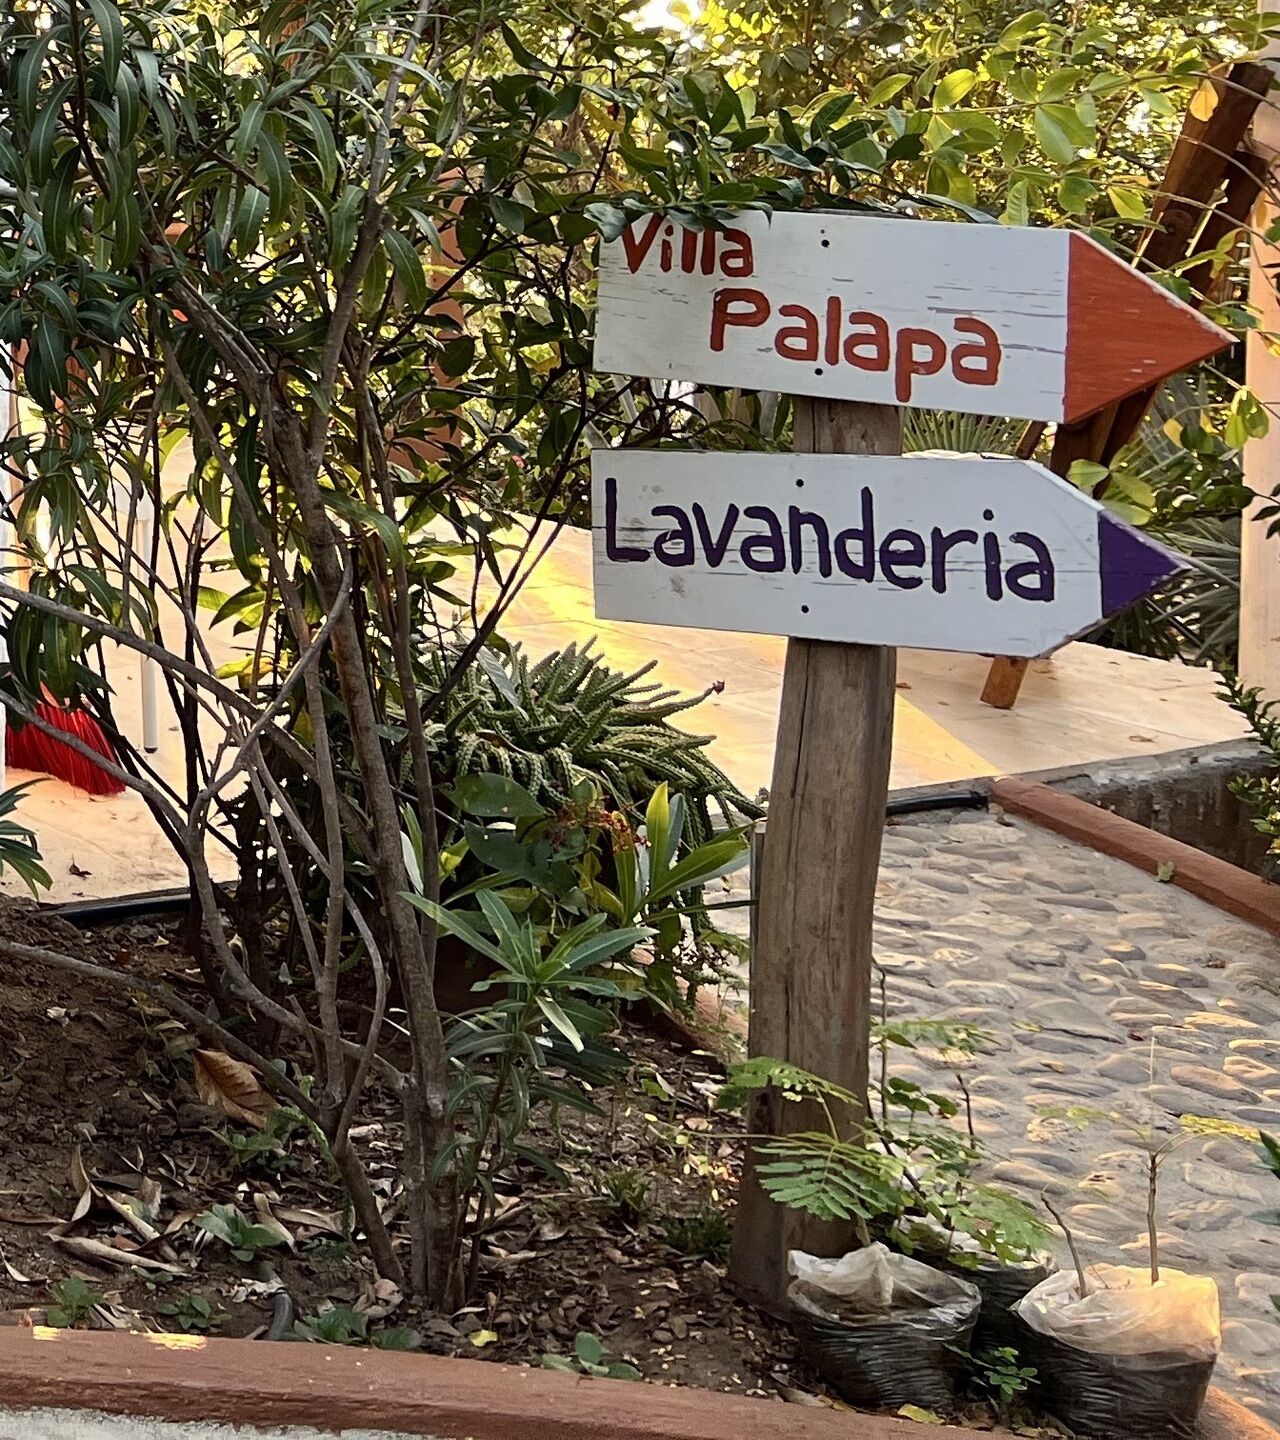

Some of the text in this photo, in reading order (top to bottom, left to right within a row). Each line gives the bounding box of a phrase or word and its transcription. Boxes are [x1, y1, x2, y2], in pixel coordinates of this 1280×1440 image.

[621, 212, 753, 277] Villa
[710, 288, 1001, 402] Palapa
[604, 477, 1055, 602] Lavanderia
